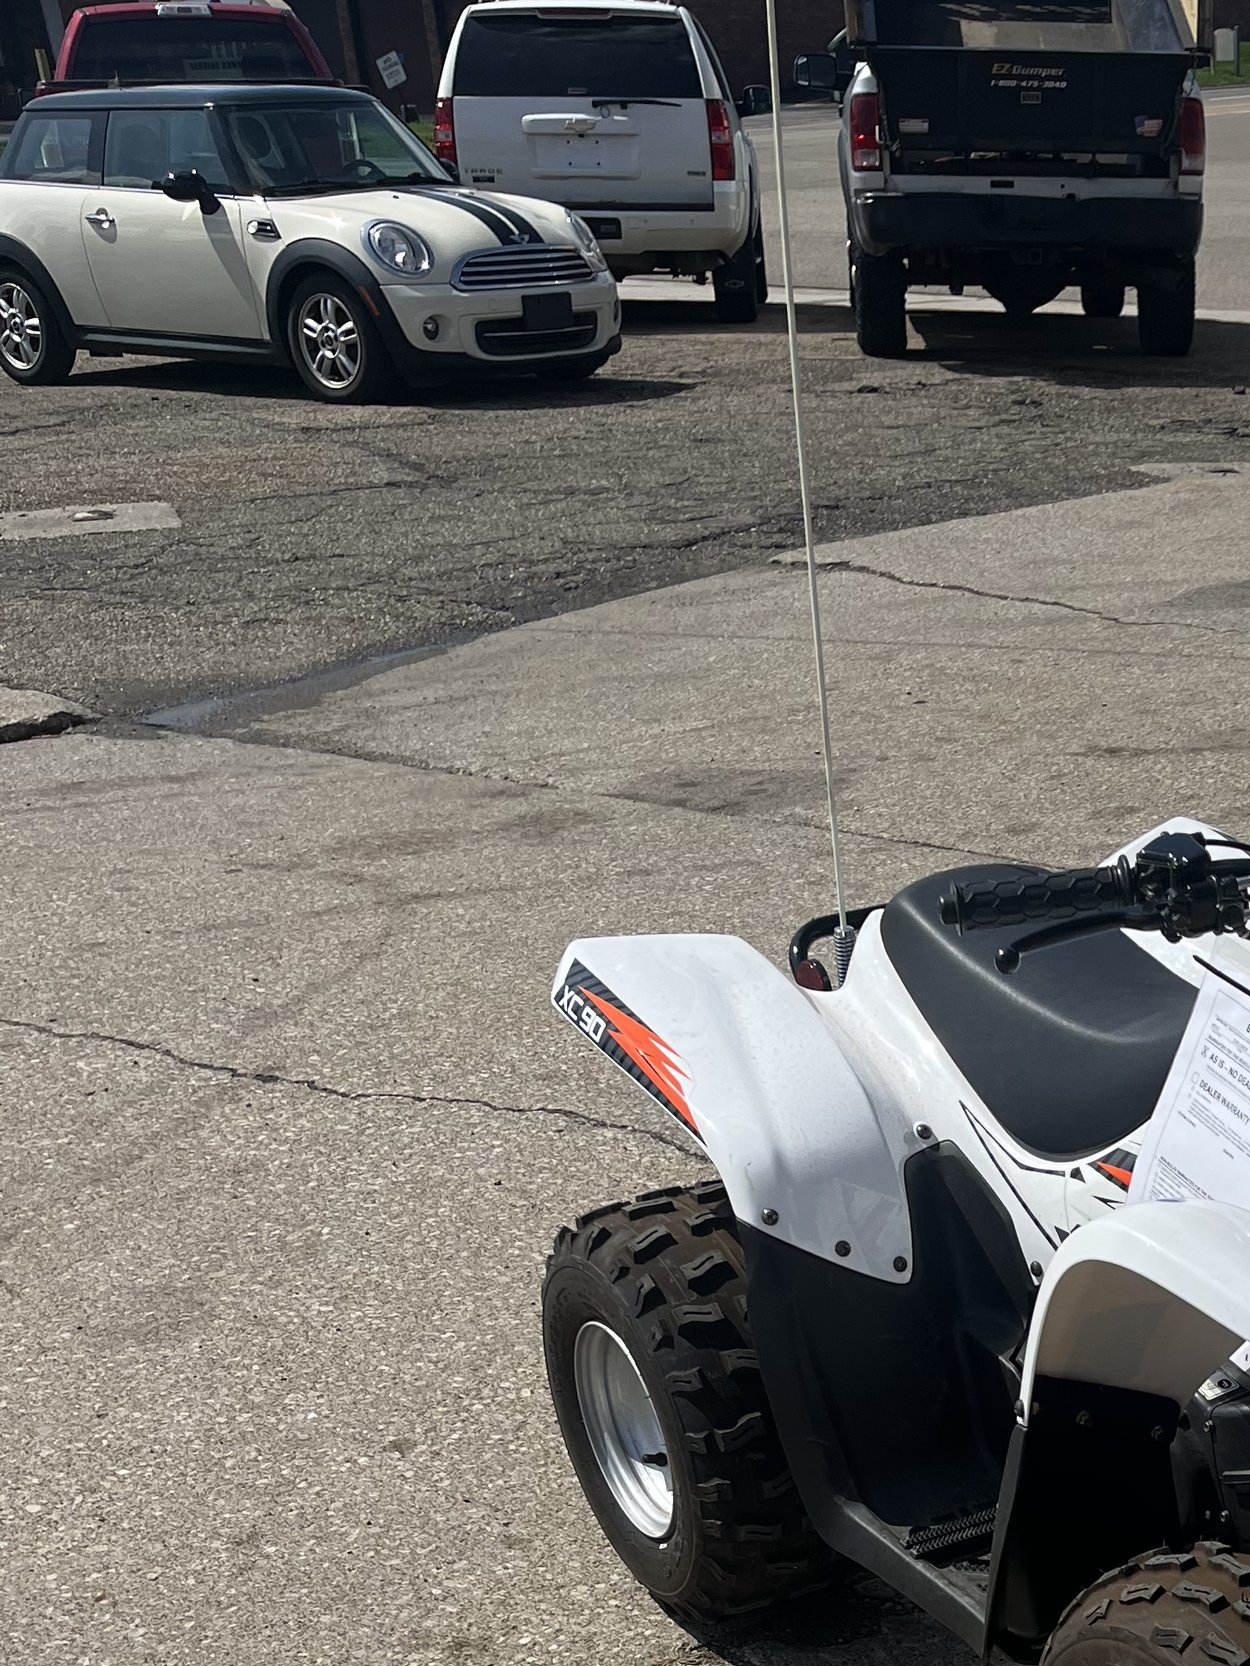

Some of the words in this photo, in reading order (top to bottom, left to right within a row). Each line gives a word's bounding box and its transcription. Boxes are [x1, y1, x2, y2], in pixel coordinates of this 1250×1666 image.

[1209, 1053, 1218, 1064] AS
[1217, 1060, 1226, 1069] IS
[1228, 1066, 1239, 1079] NO
[1199, 1080, 1222, 1101] DEALER
[1220, 1096, 1250, 1125] WARRANTY
